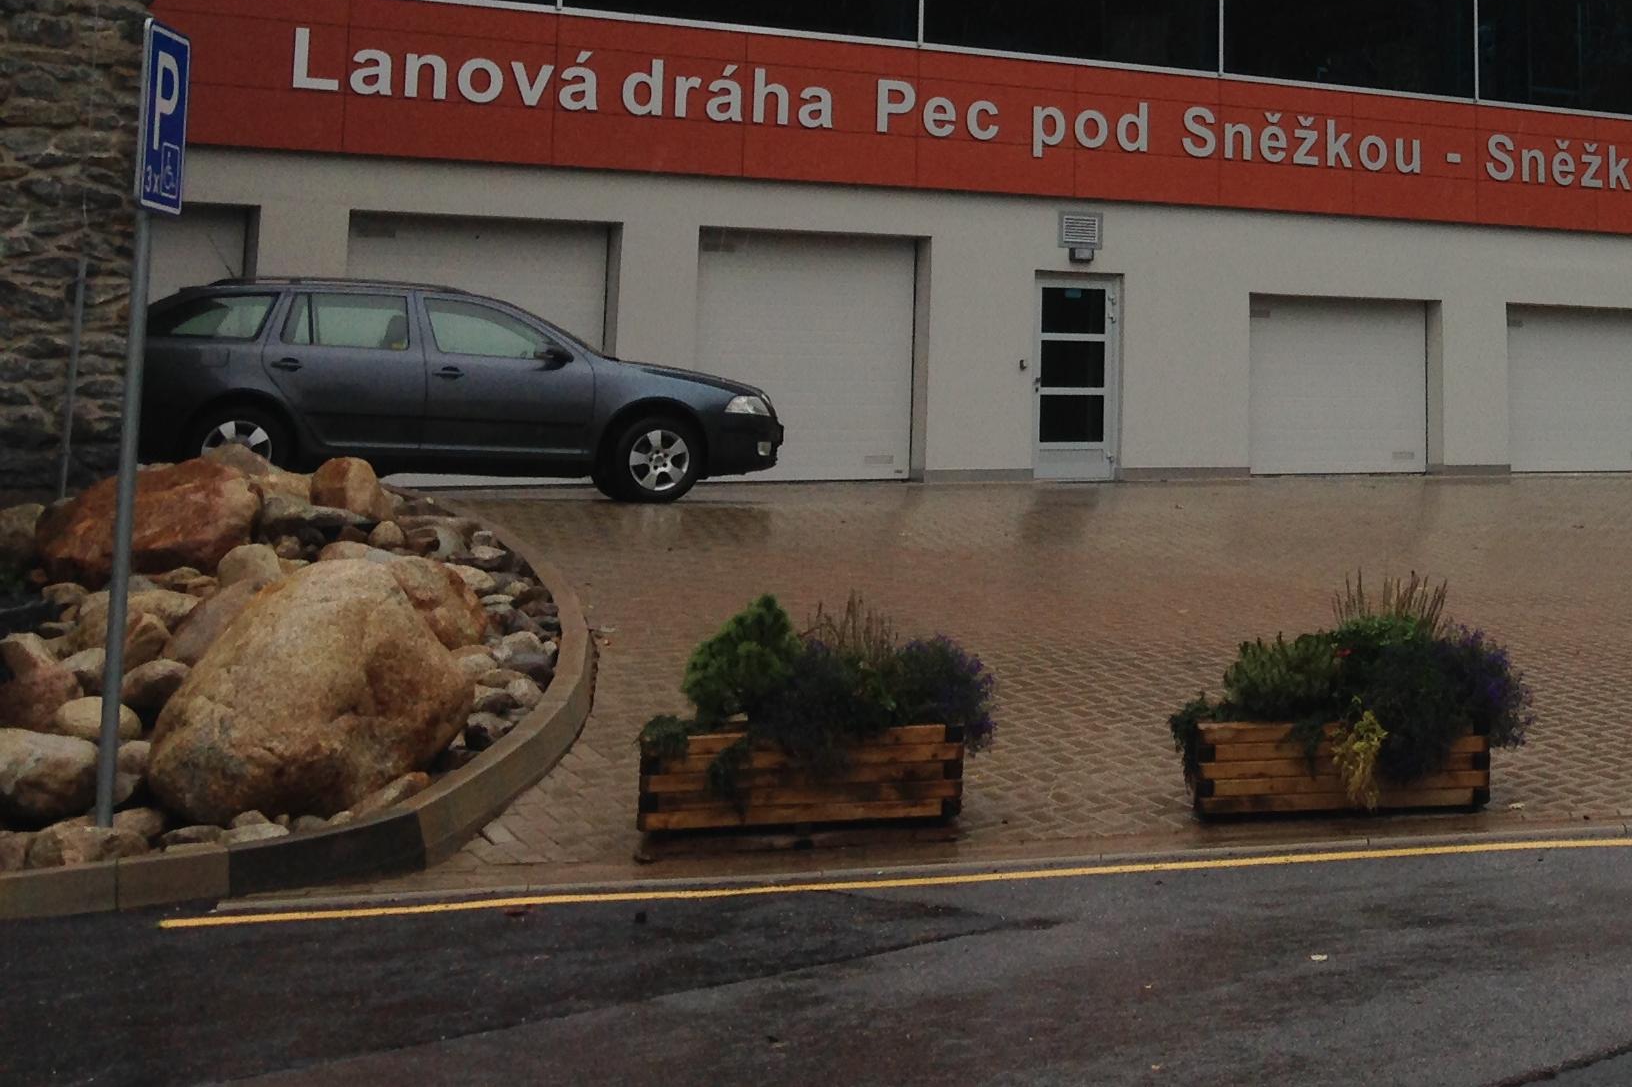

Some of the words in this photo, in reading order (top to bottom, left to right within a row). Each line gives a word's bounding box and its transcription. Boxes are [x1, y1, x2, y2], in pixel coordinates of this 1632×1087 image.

[152, 50, 180, 151] P
[292, 27, 600, 111] Lanová
[622, 58, 833, 130] dráha
[876, 78, 999, 140] Pec
[1032, 101, 1149, 158] pod
[1182, 106, 1421, 174] Sněžkou
